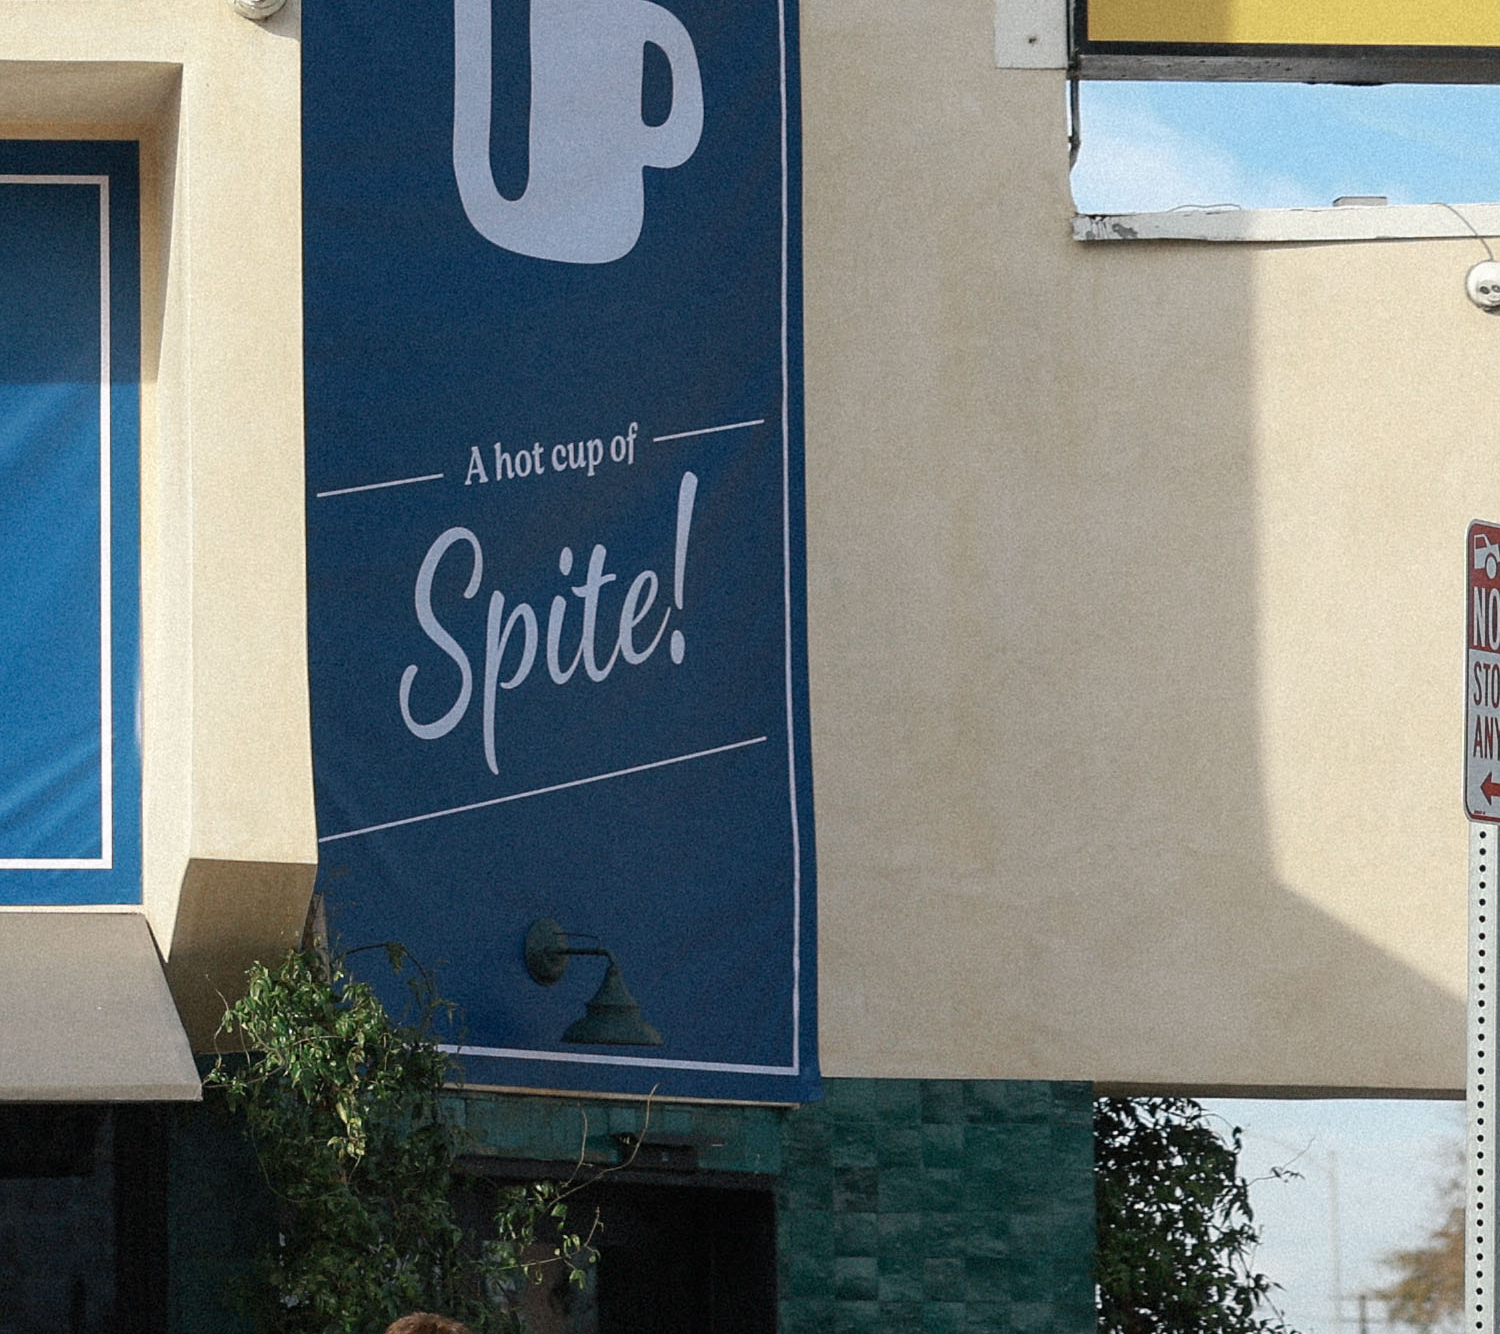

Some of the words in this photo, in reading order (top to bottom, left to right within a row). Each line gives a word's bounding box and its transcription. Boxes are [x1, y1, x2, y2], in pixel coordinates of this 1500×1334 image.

[464, 446, 489, 485] A
[494, 442, 545, 481] hot
[552, 438, 603, 477] cup
[610, 422, 639, 465] of
[399, 471, 698, 775] Spite!
[1473, 586, 1500, 651] NO
